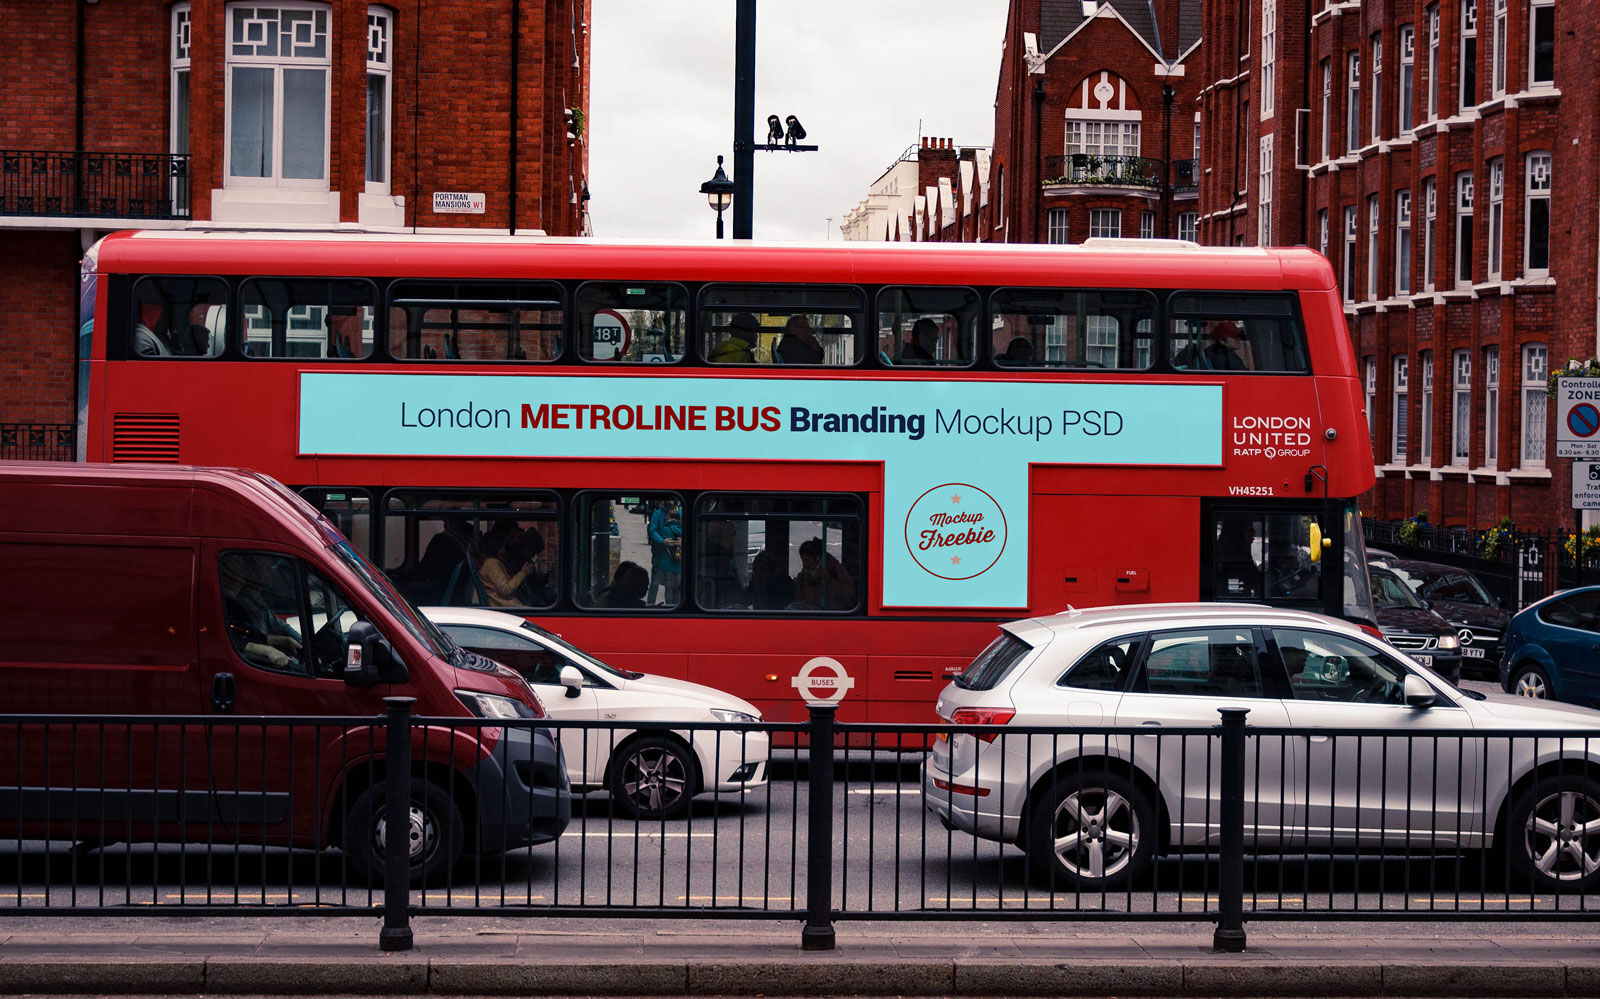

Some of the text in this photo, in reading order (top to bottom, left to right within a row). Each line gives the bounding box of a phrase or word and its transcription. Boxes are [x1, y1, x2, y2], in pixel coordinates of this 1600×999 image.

[435, 193, 469, 201] PORTMAN
[435, 200, 483, 209] MANSIONS W1
[1568, 390, 1600, 400] ZONE
[401, 400, 1124, 442] London METROLINE BUS Branding Mockup PSD
[1233, 416, 1311, 429] LONDON
[1233, 432, 1311, 446] UNITED
[1233, 448, 1311, 457] RATP GROUP
[1228, 486, 1274, 496] VH45251
[929, 511, 985, 528] Mockup
[918, 526, 996, 551] Freebie
[811, 678, 835, 686] BUSES
